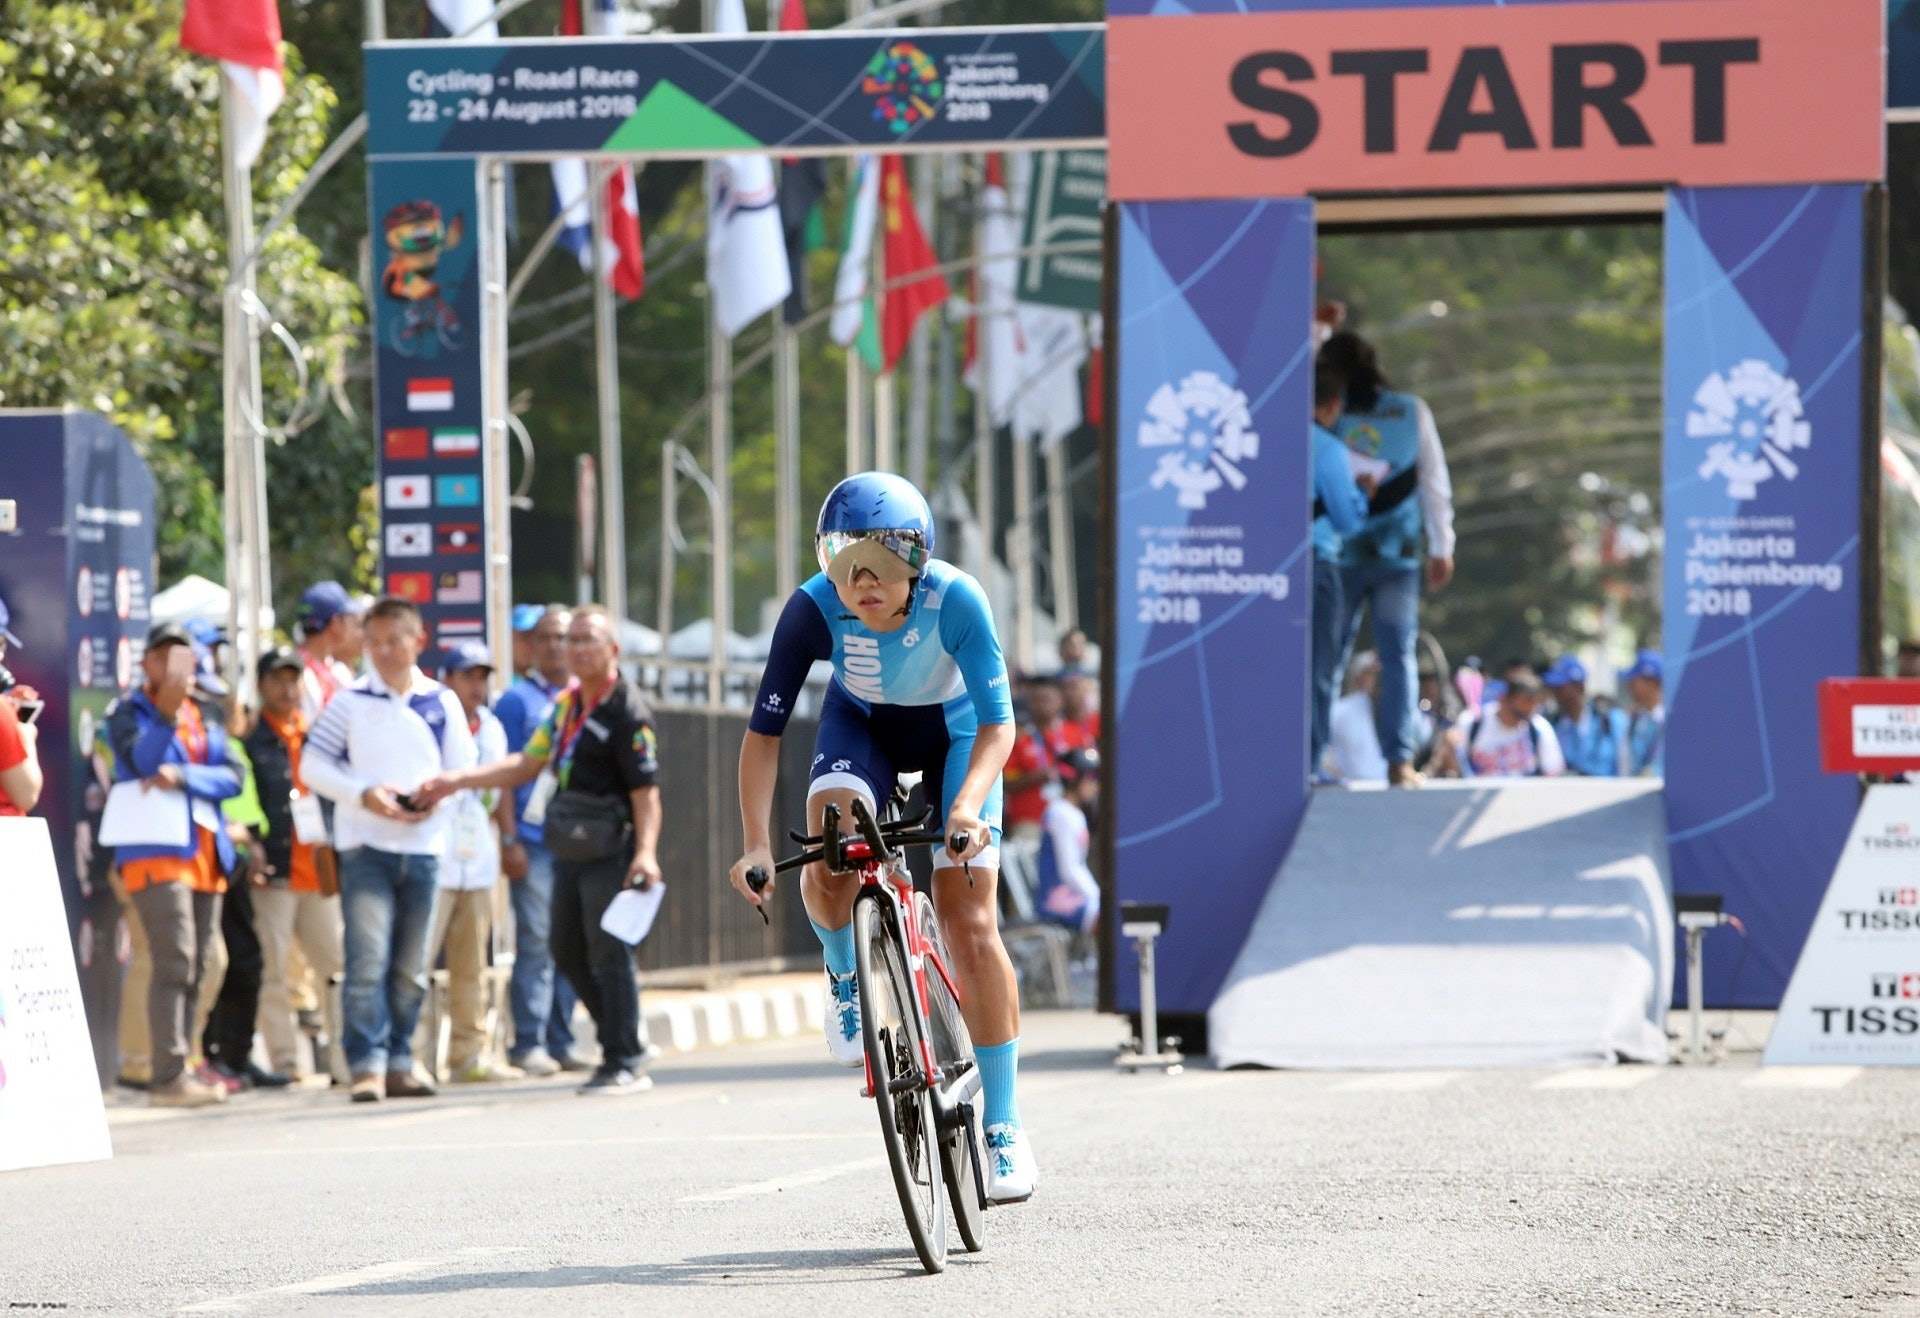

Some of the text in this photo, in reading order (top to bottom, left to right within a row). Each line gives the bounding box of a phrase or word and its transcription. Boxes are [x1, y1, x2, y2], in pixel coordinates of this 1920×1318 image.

[407, 69, 494, 96] Cycling
[514, 67, 577, 90] Road
[580, 65, 639, 89] Race
[946, 65, 1018, 83] Jakarta
[944, 82, 1048, 103] Palembang
[1225, 37, 1760, 158] START
[408, 99, 438, 122] 22
[457, 98, 489, 120] 24
[492, 97, 577, 124] August
[581, 95, 637, 118] 2018
[946, 101, 991, 121] 2018
[1137, 542, 1243, 567] Jakarta
[1685, 533, 1795, 558] Jakarta
[1137, 569, 1289, 600] Palembang
[1685, 559, 1842, 591] Palembang
[1137, 597, 1200, 623] 2018
[1686, 588, 1751, 615] 2018
